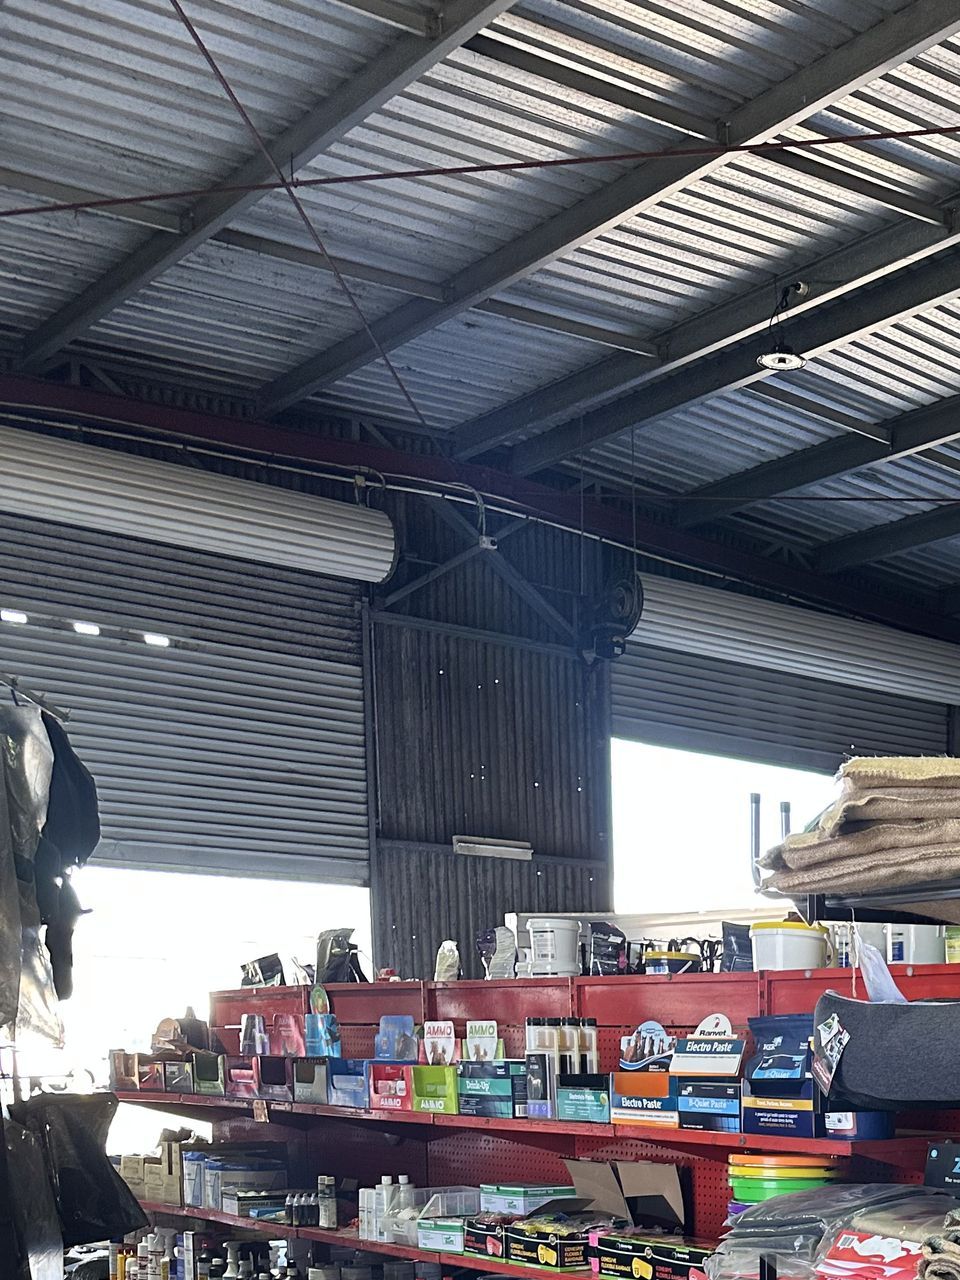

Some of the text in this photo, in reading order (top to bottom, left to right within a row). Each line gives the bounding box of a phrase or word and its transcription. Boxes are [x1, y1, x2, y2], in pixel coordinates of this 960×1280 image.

[426, 1025, 452, 1037] AMMO
[468, 1024, 495, 1036] AMMO
[699, 1029, 727, 1037] Ranvet
[686, 1041, 733, 1052] Electro Paste
[380, 1097, 401, 1107] AMMO
[420, 1099, 445, 1109] AMMO
[622, 1098, 662, 1109] Electro Paste
